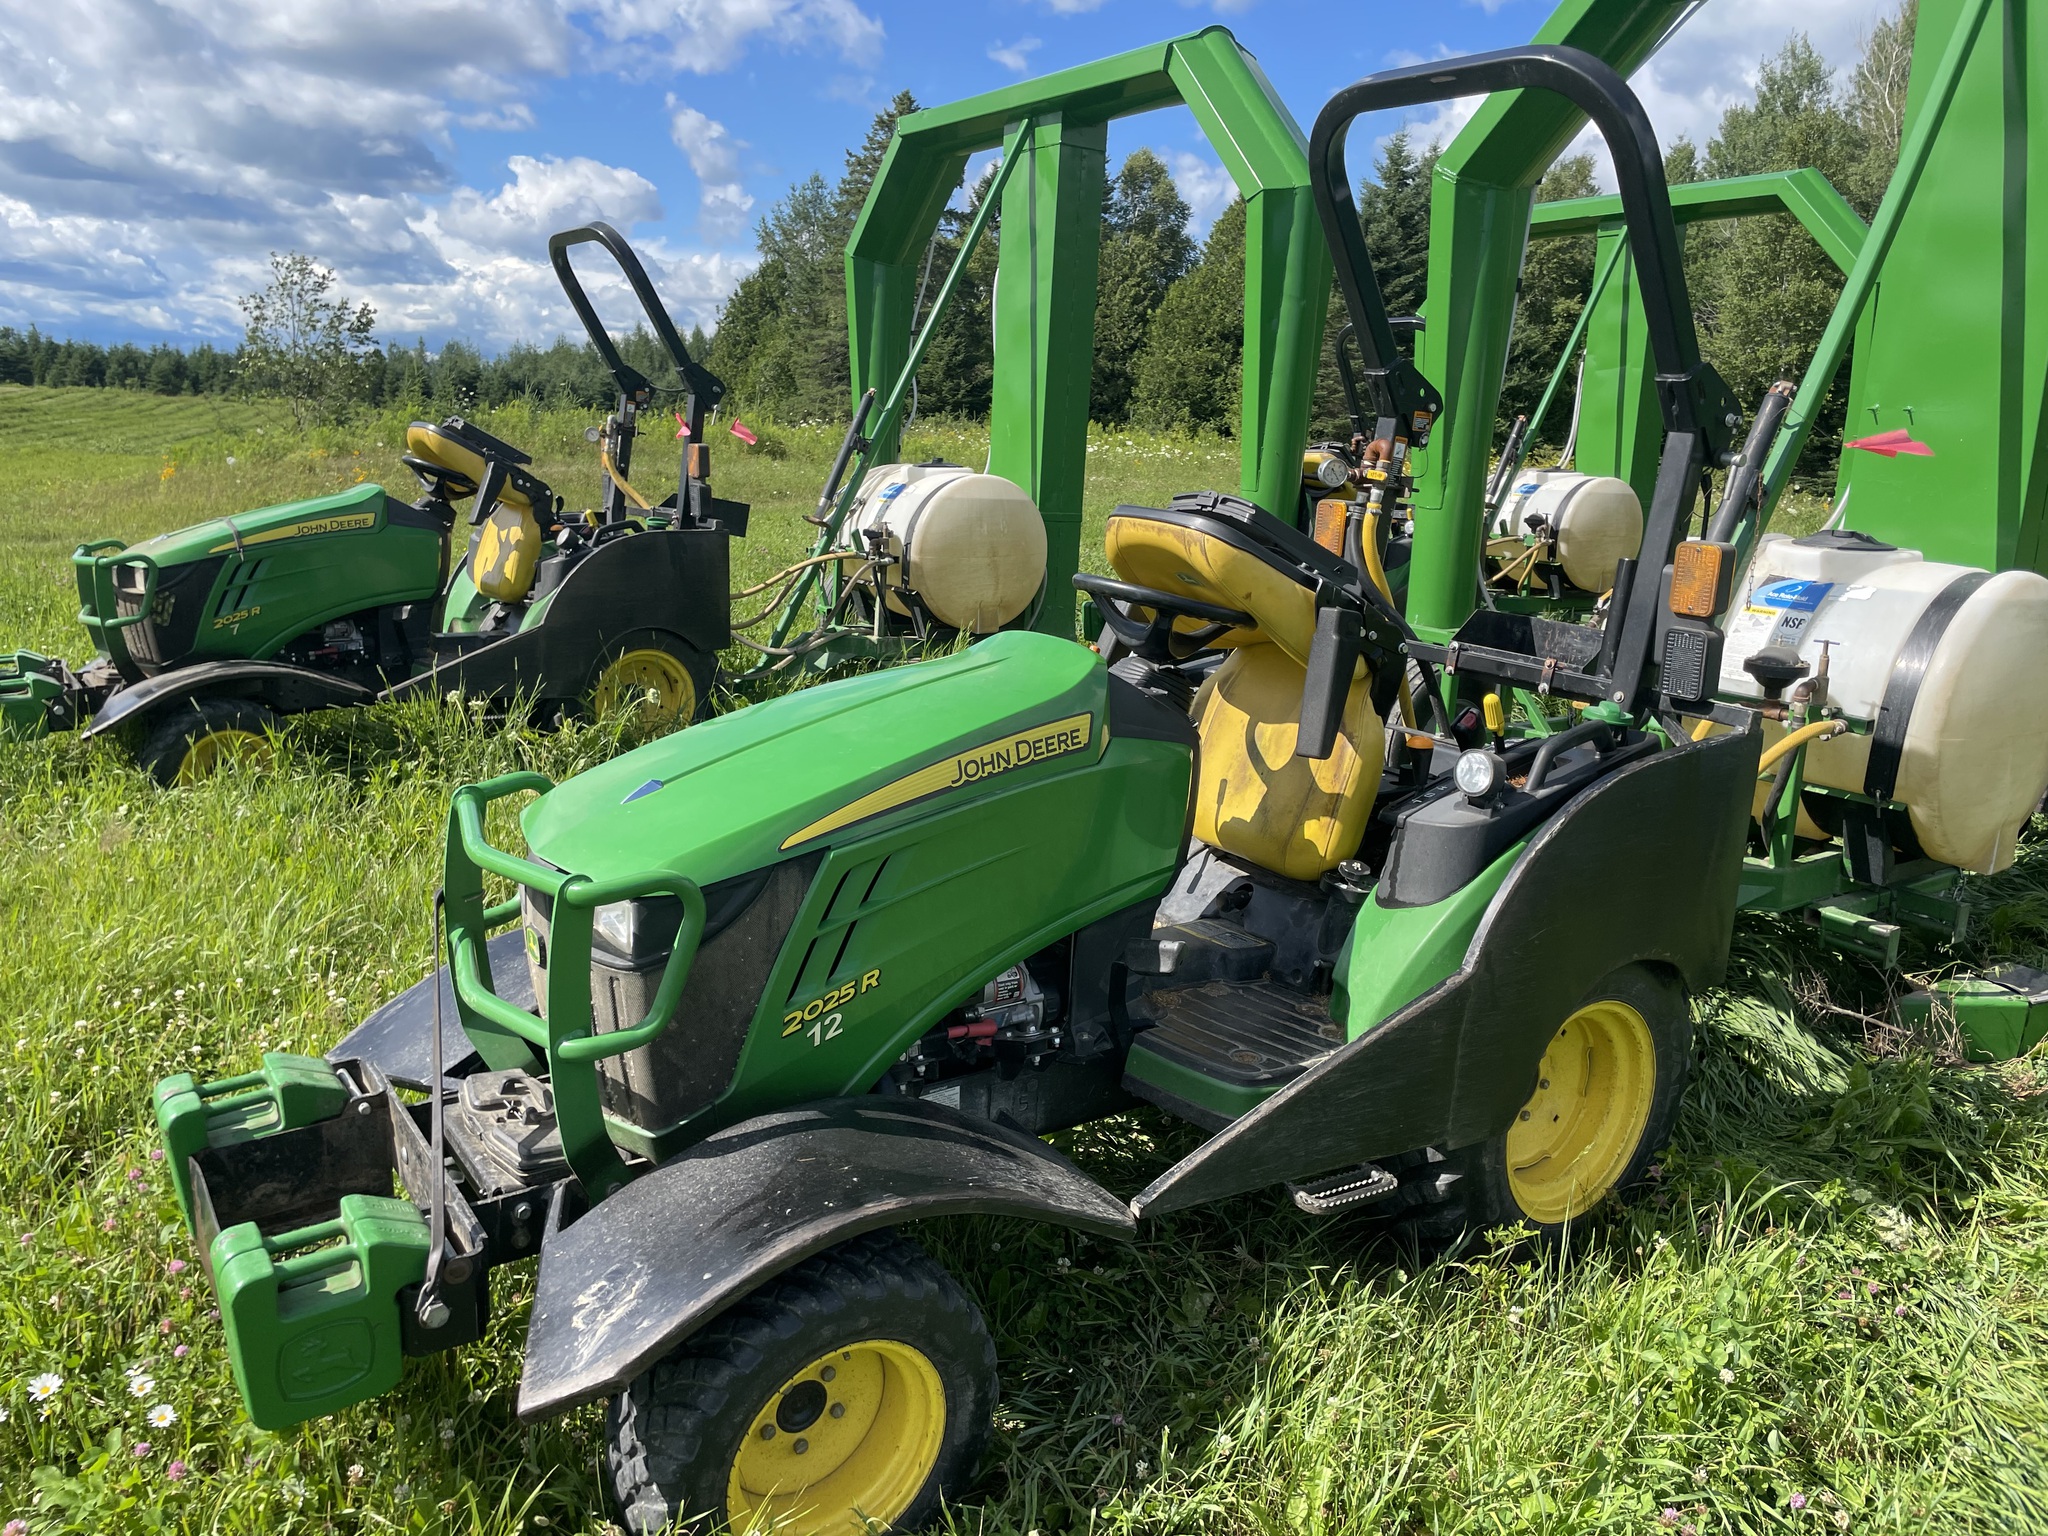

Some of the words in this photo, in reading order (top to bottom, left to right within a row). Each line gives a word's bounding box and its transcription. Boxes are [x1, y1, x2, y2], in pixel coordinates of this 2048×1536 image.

[295, 523, 328, 536] JOHN
[330, 518, 370, 531] DEERE
[213, 609, 249, 630] 2025
[251, 606, 261, 617] R
[230, 623, 240, 636] 7
[1781, 616, 1806, 630] NSF
[950, 748, 1012, 785] JOHN
[1014, 728, 1082, 763] DEERE
[781, 980, 857, 1038] 2025
[861, 968, 881, 994] R
[806, 1012, 844, 1047] 12
